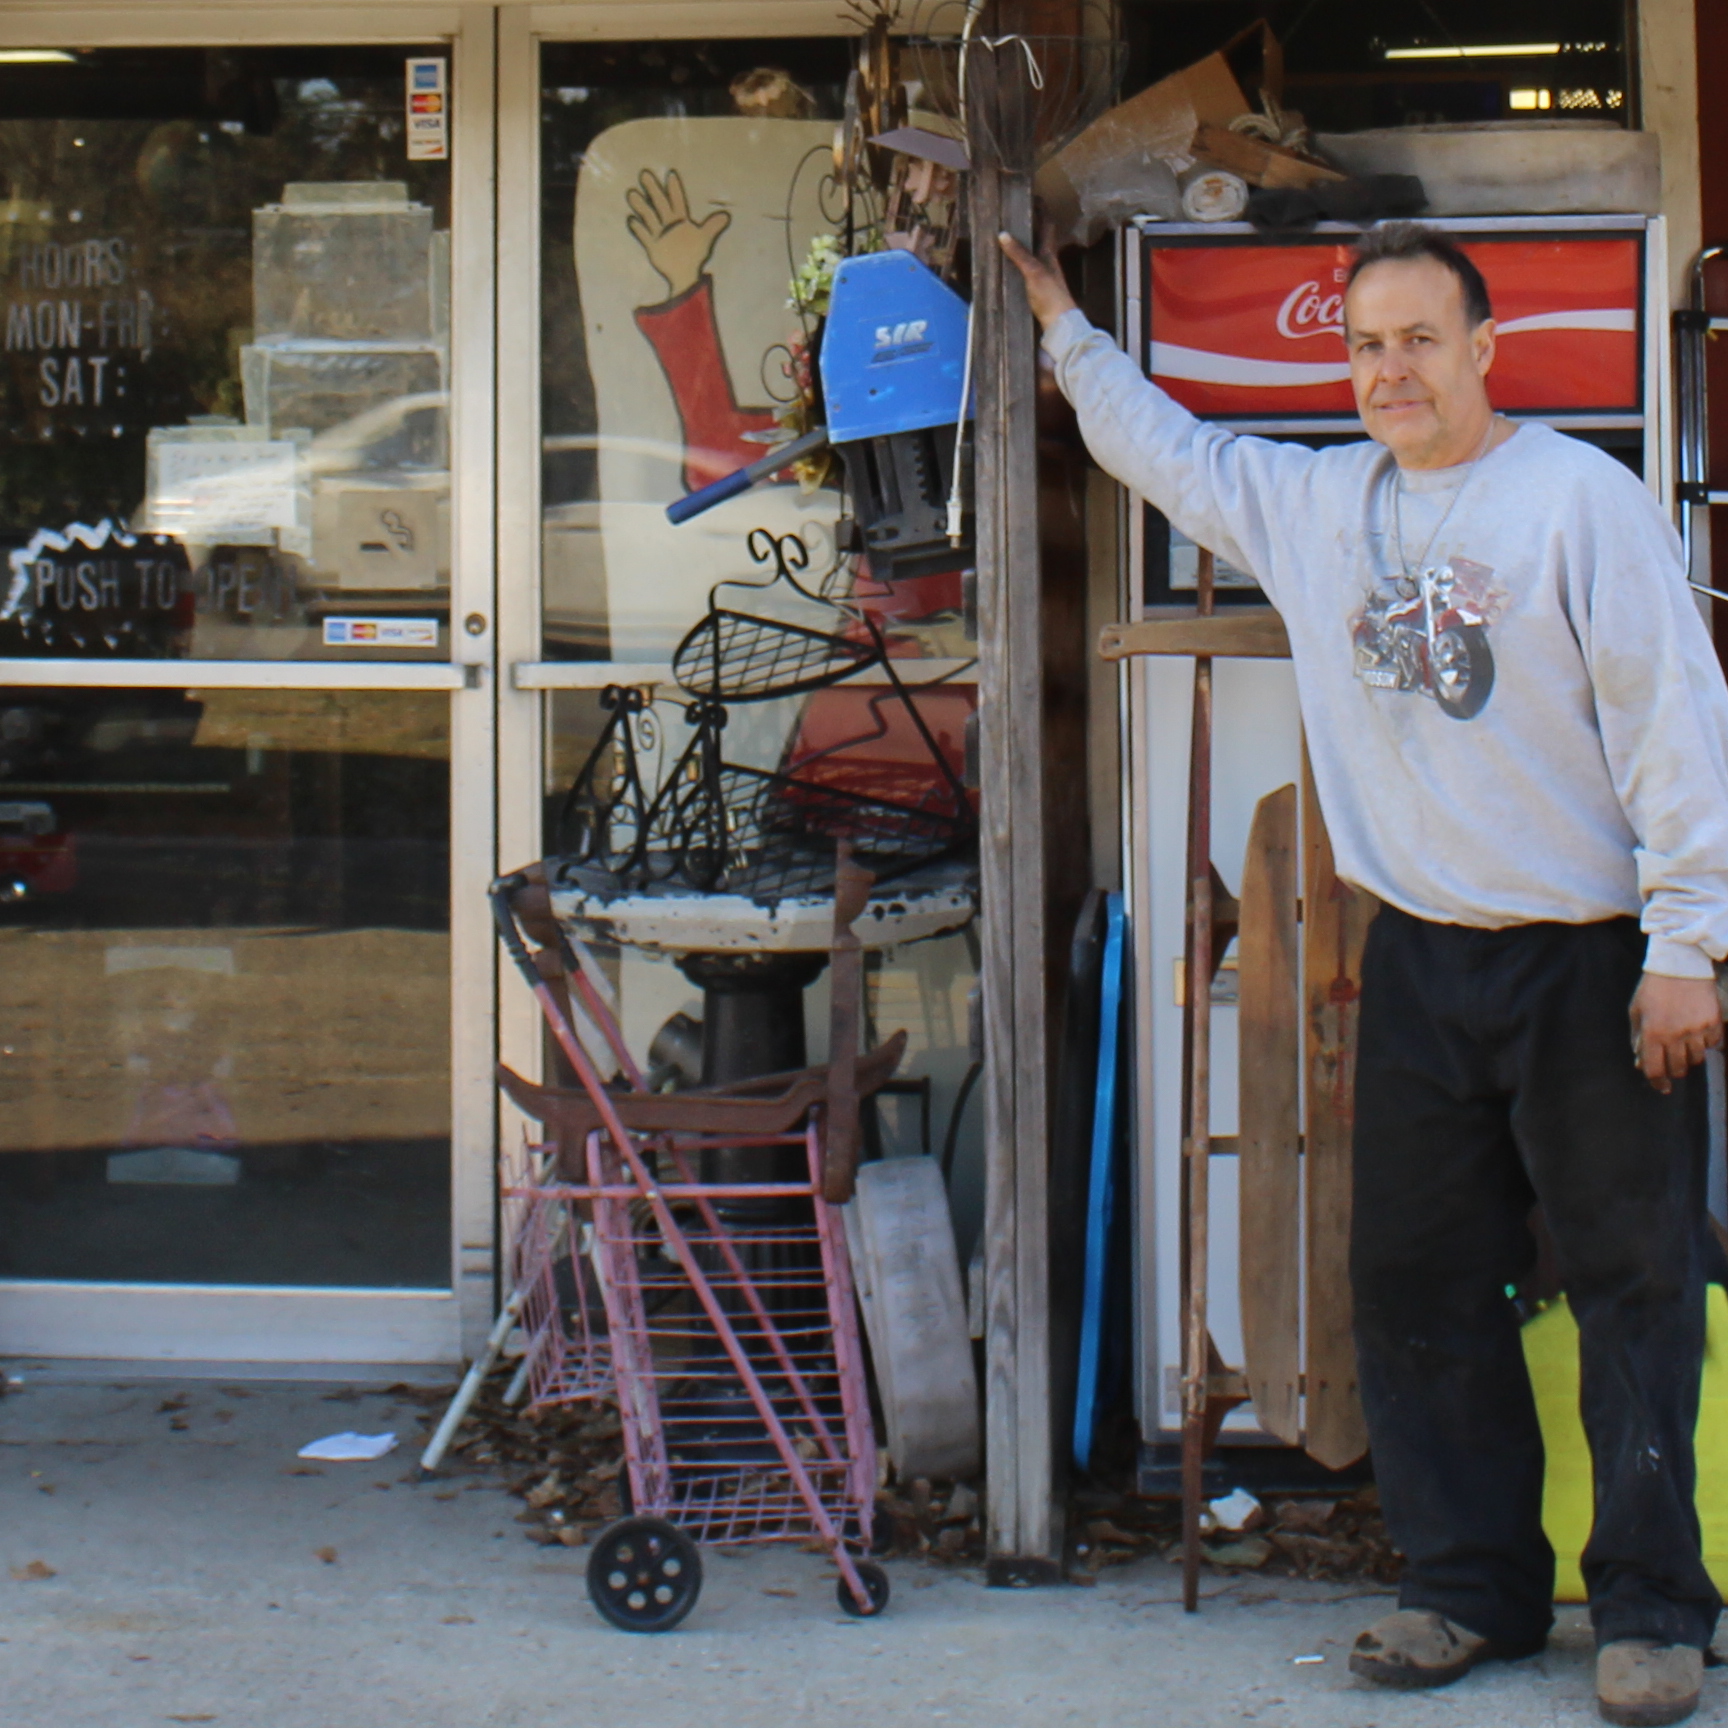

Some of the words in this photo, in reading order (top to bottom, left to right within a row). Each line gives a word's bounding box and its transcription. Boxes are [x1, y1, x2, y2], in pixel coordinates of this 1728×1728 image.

[39, 355, 126, 408] SAT:
[34, 557, 122, 611] PUSH
[134, 557, 178, 611] TO
